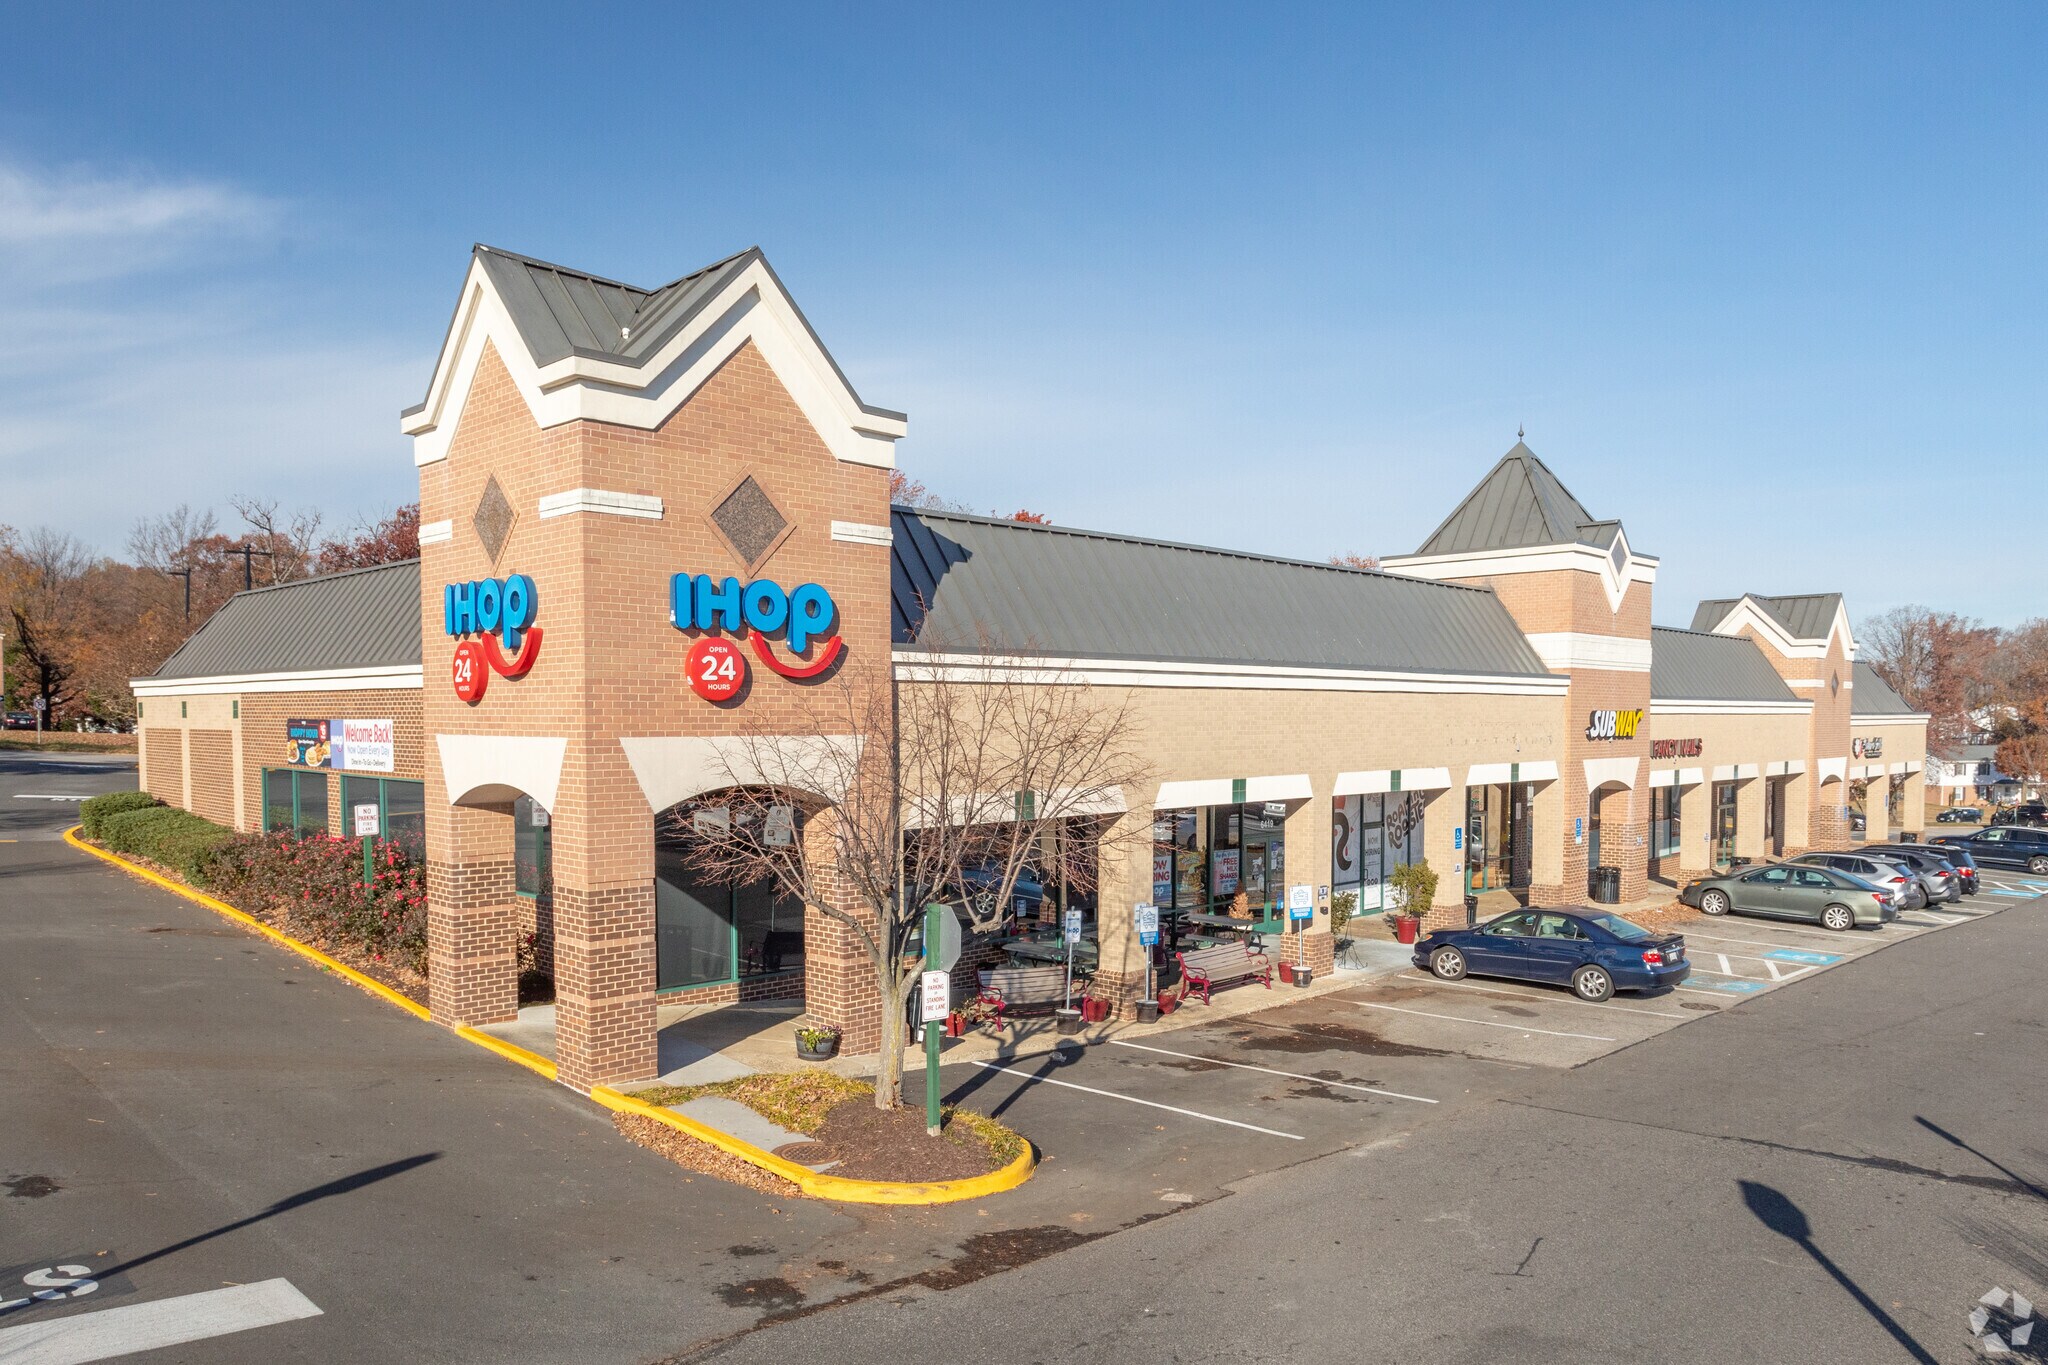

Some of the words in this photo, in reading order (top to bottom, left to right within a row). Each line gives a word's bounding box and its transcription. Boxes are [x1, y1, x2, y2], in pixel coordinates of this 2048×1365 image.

[445, 574, 536, 650] IHOP
[670, 573, 834, 653] IHOP
[454, 658, 472, 683] 24
[701, 656, 736, 681] 24
[345, 724, 373, 743] Welcome
[374, 724, 391, 743] Back!
[1587, 709, 1644, 739] SUBWAY
[357, 745, 368, 755] Open
[369, 745, 380, 757] Every
[381, 746, 389, 758] Day
[1652, 739, 1678, 758] FANCY
[1679, 738, 1703, 758] NAILS
[1223, 857, 1238, 865] FREE
[1364, 848, 1381, 856] HIRING
[927, 983, 944, 991] PARKING
[926, 996, 945, 1004] STANDING
